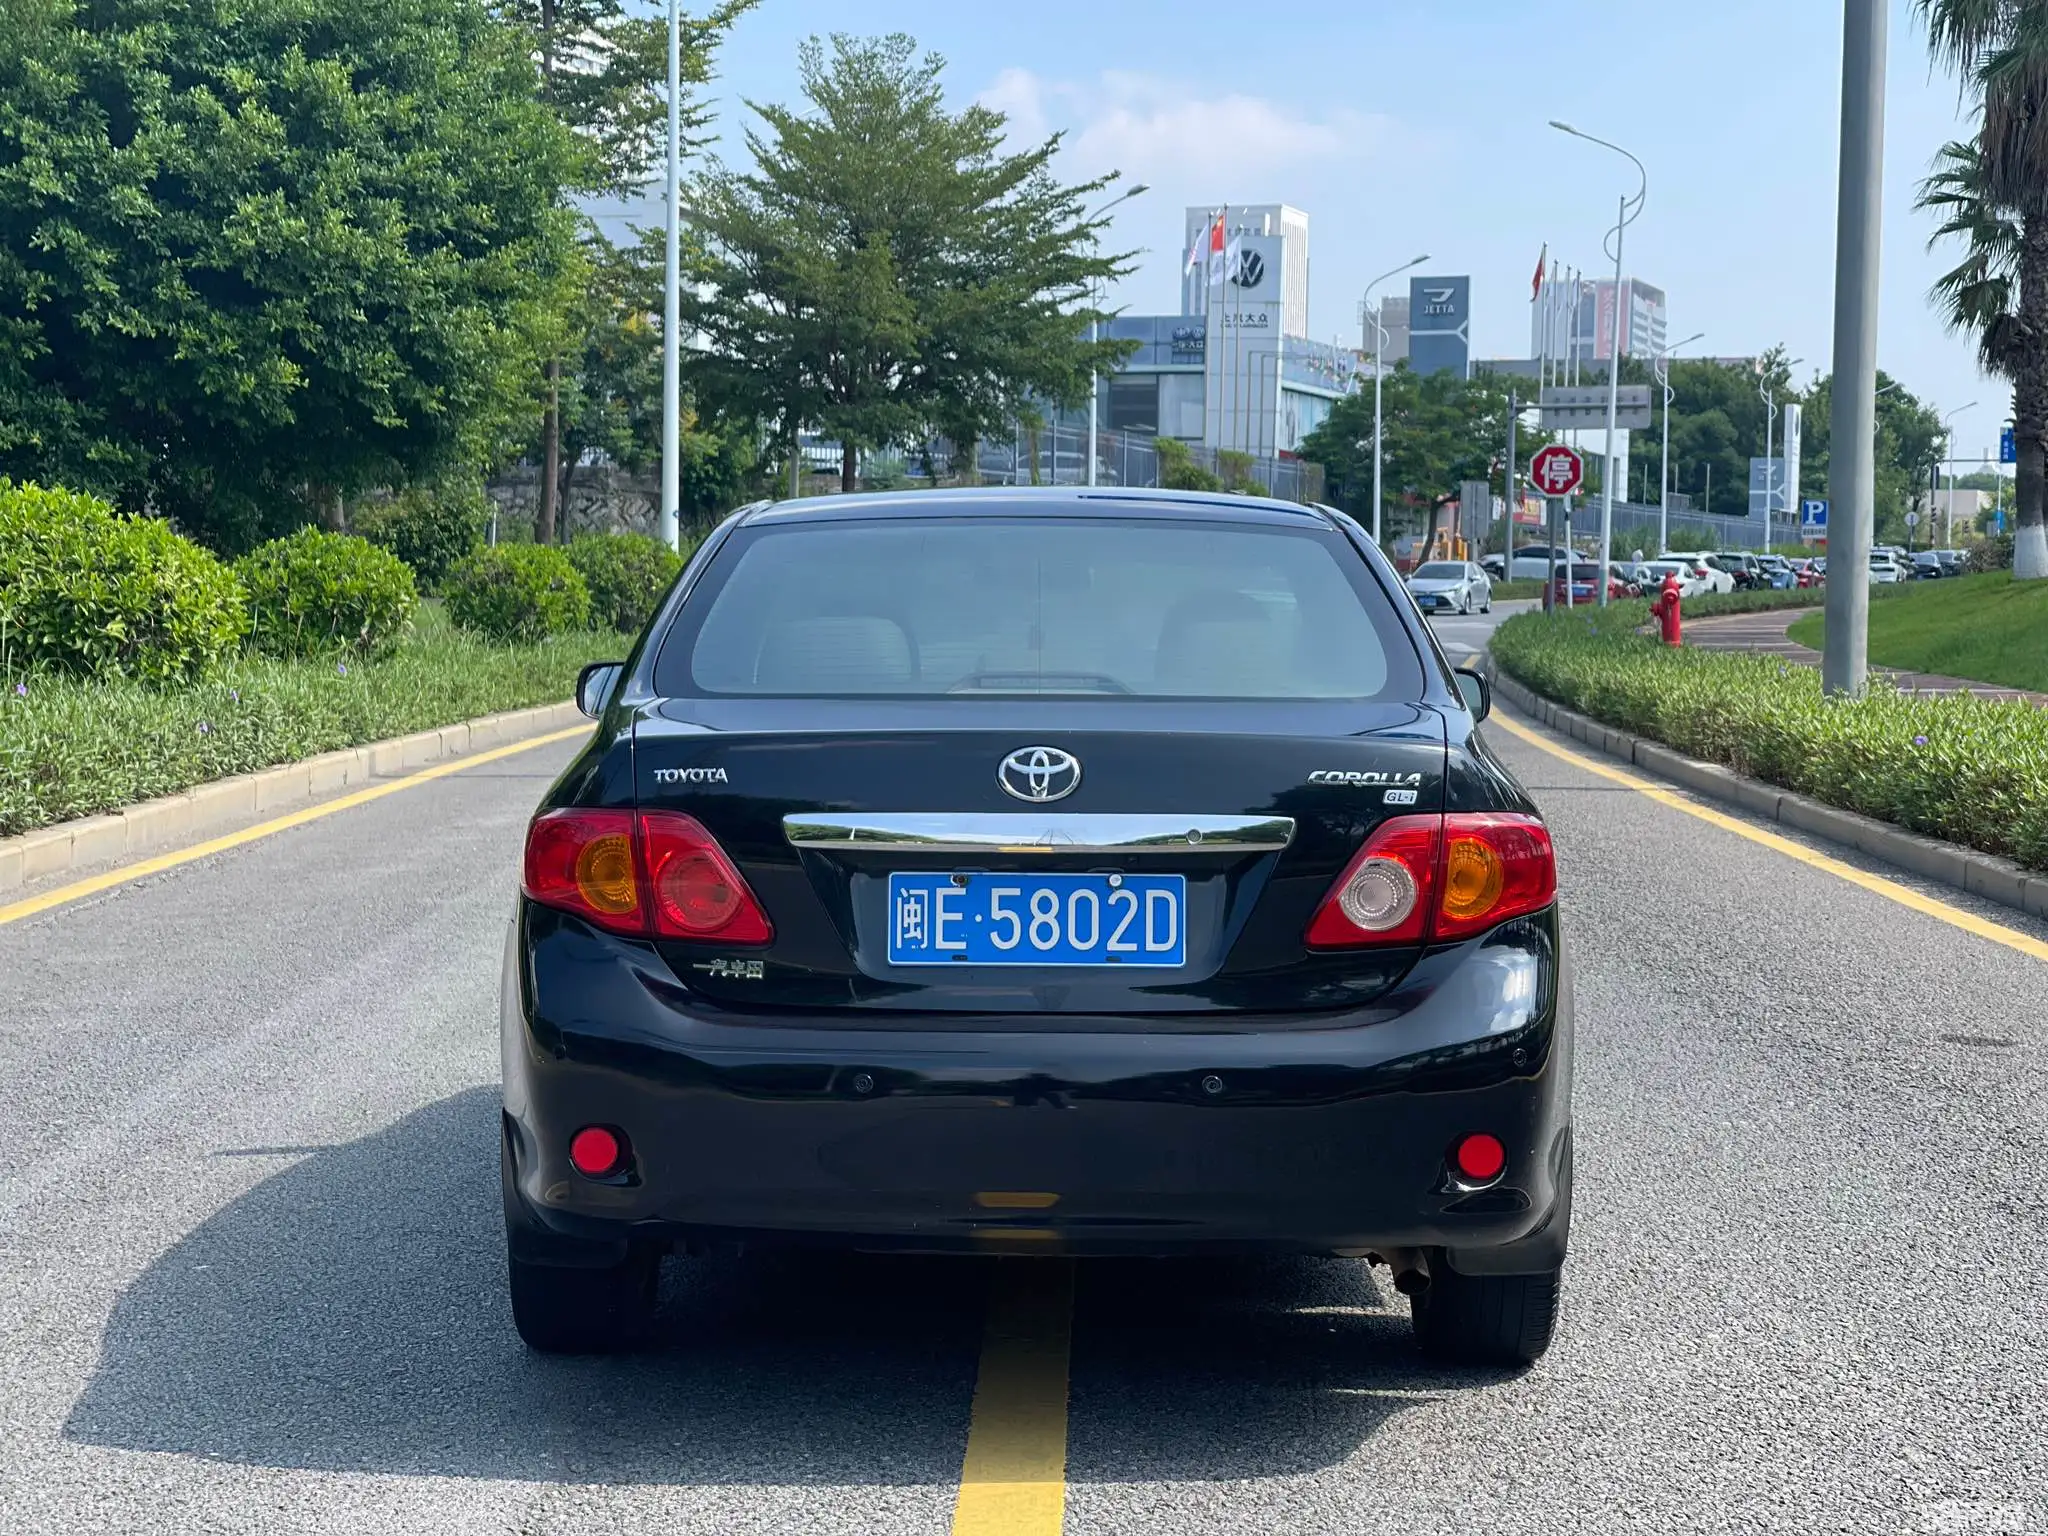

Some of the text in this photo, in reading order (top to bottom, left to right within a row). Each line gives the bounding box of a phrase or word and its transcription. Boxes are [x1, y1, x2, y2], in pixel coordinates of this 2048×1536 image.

[1424, 304, 1455, 314] JETTA
[1540, 453, 1573, 490] 停
[1804, 500, 1825, 525] P
[654, 767, 729, 784] TOYOTA
[1307, 770, 1422, 787] COROLLA
[1386, 790, 1416, 803] GL-i
